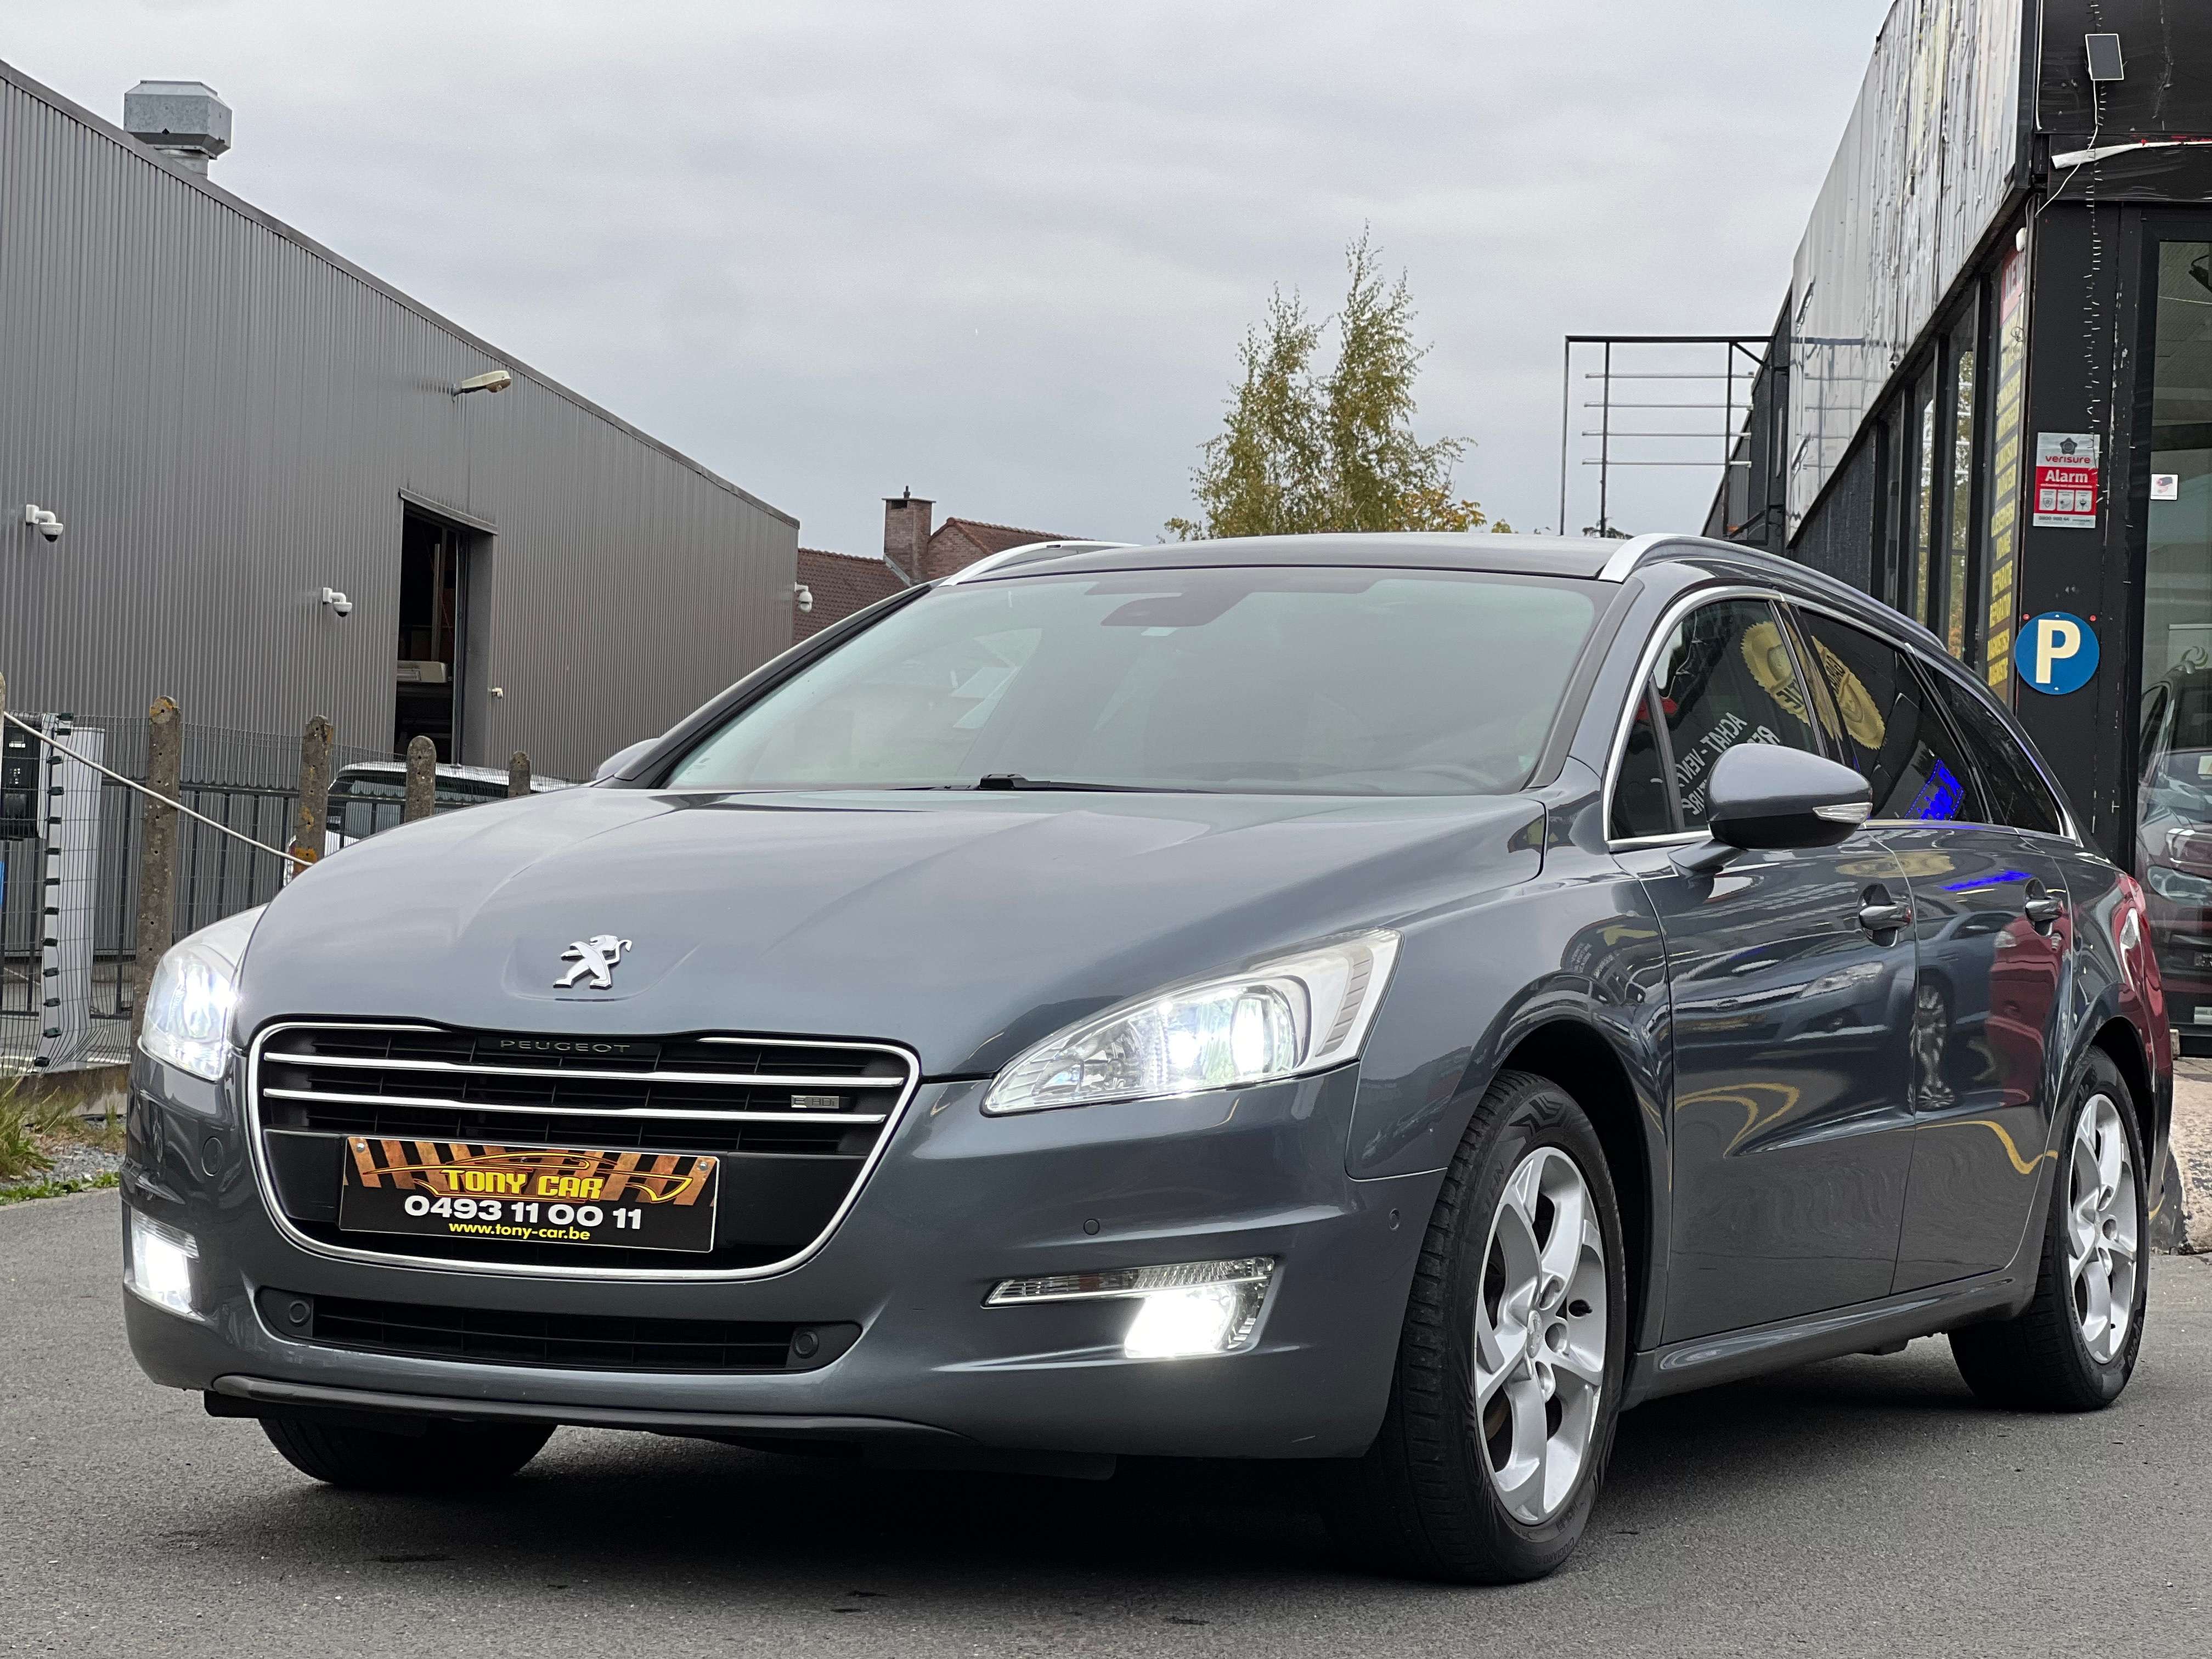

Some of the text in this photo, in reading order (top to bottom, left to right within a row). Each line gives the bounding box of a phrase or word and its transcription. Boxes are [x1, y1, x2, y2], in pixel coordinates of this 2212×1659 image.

[2045, 455, 2091, 464] verisure
[2045, 470, 2088, 483] Alarm
[2036, 619, 2081, 684] P
[499, 1040, 631, 1053] PEUGEOT
[439, 1169, 605, 1200] TONY CAR
[404, 1195, 642, 1230] 0493 11 00 11
[449, 1222, 590, 1240] www.tony-car.be
